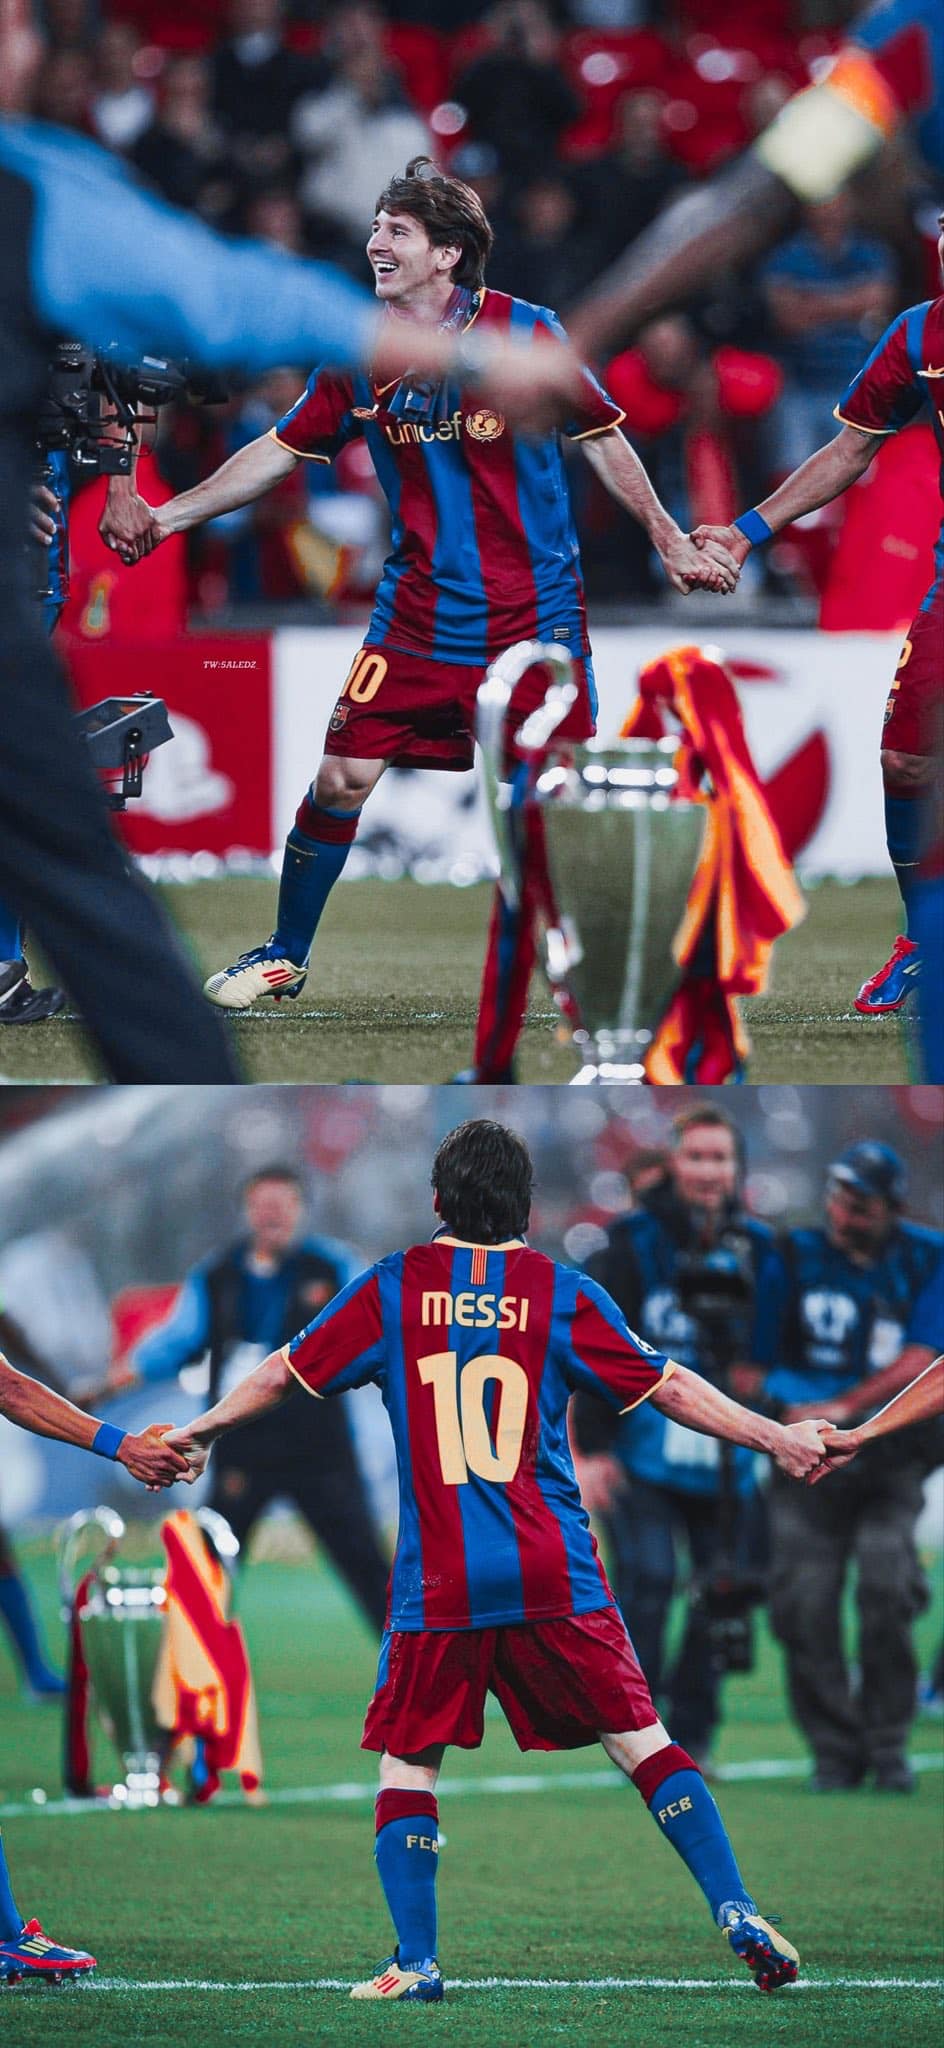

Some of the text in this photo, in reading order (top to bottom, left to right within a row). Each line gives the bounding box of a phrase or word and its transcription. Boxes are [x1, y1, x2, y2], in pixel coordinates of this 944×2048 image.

[386, 411, 462, 445] unicef
[340, 649, 389, 703] 10
[421, 1291, 529, 1332] MESSI
[416, 1351, 529, 1485] 10
[658, 1796, 693, 1824] FCB
[406, 1834, 439, 1854] FCB
